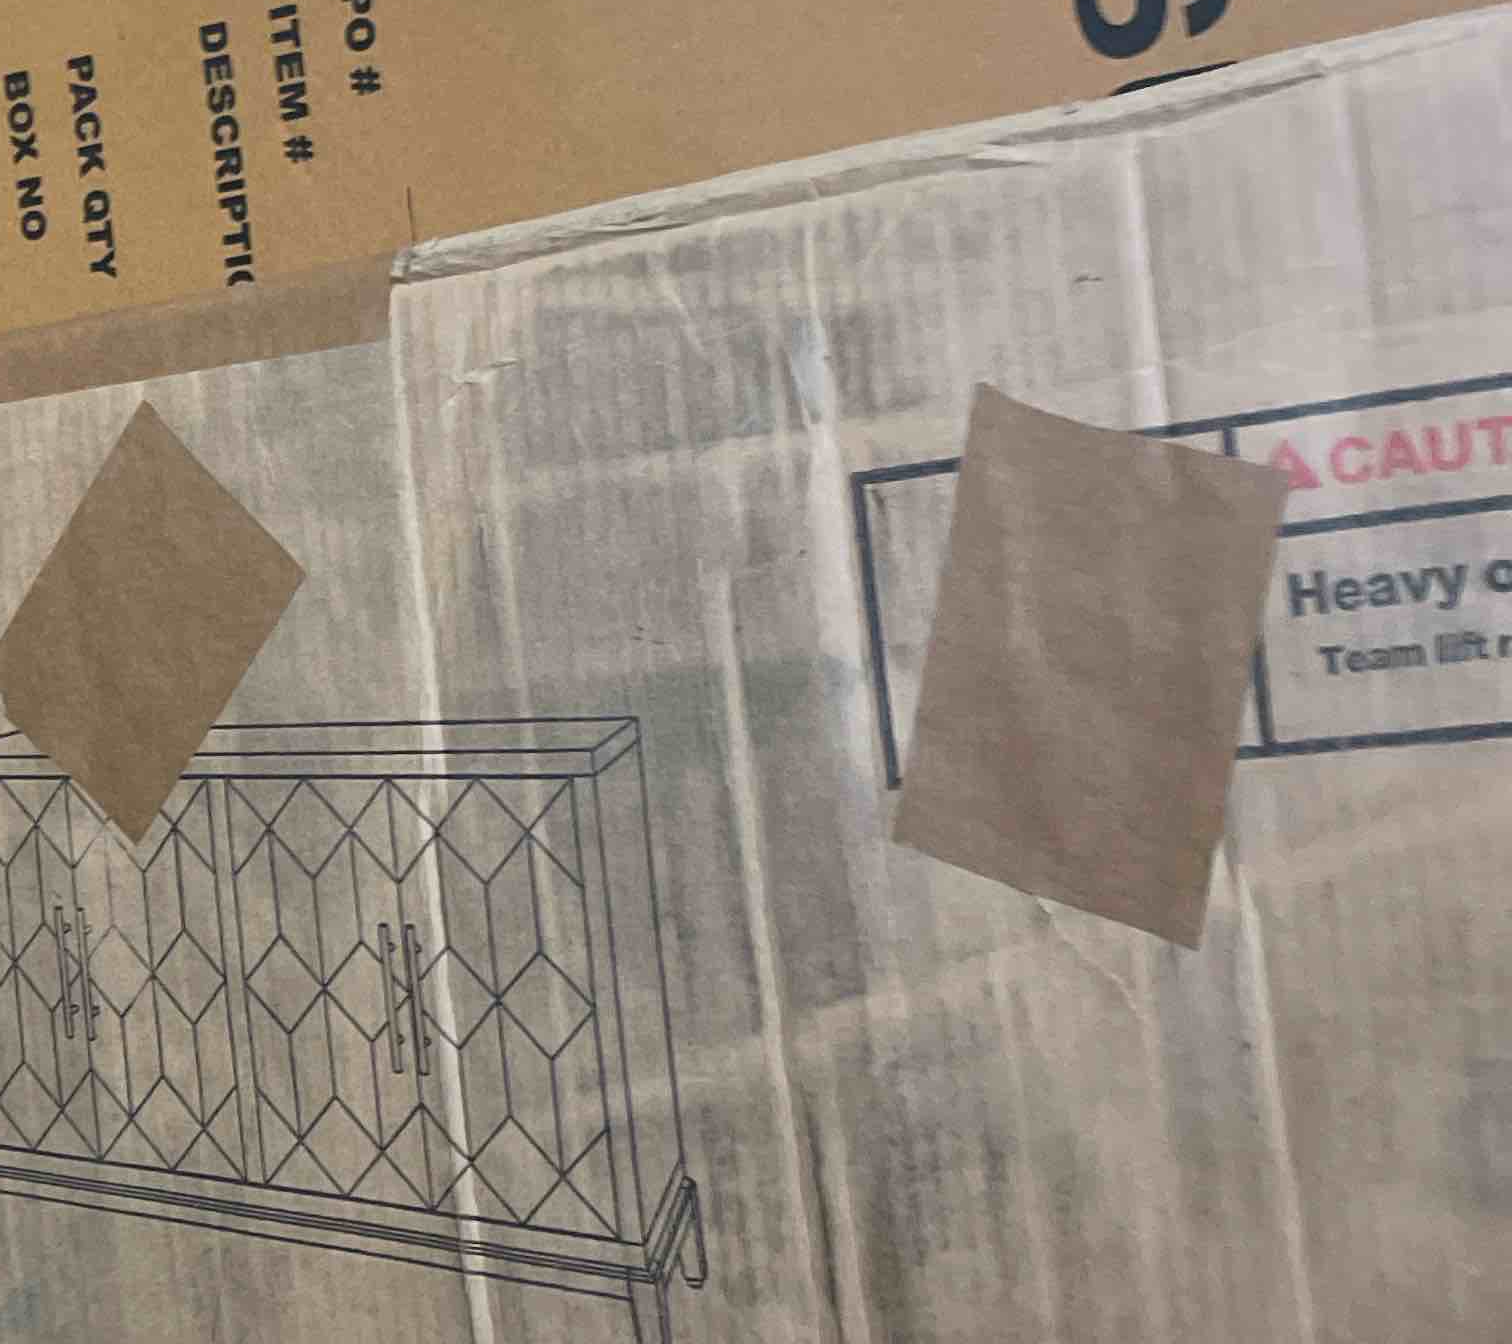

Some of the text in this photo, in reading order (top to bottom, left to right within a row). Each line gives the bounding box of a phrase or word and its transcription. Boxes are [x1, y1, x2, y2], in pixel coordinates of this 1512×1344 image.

[269, 4, 314, 164] ITEM #
[349, 65, 381, 96] #
[3, 70, 47, 240] BOX NO
[67, 55, 117, 278] PACK QTY
[1330, 416, 1512, 485] CAUT
[1288, 563, 1468, 618] Heavy
[1317, 644, 1428, 675] Team
